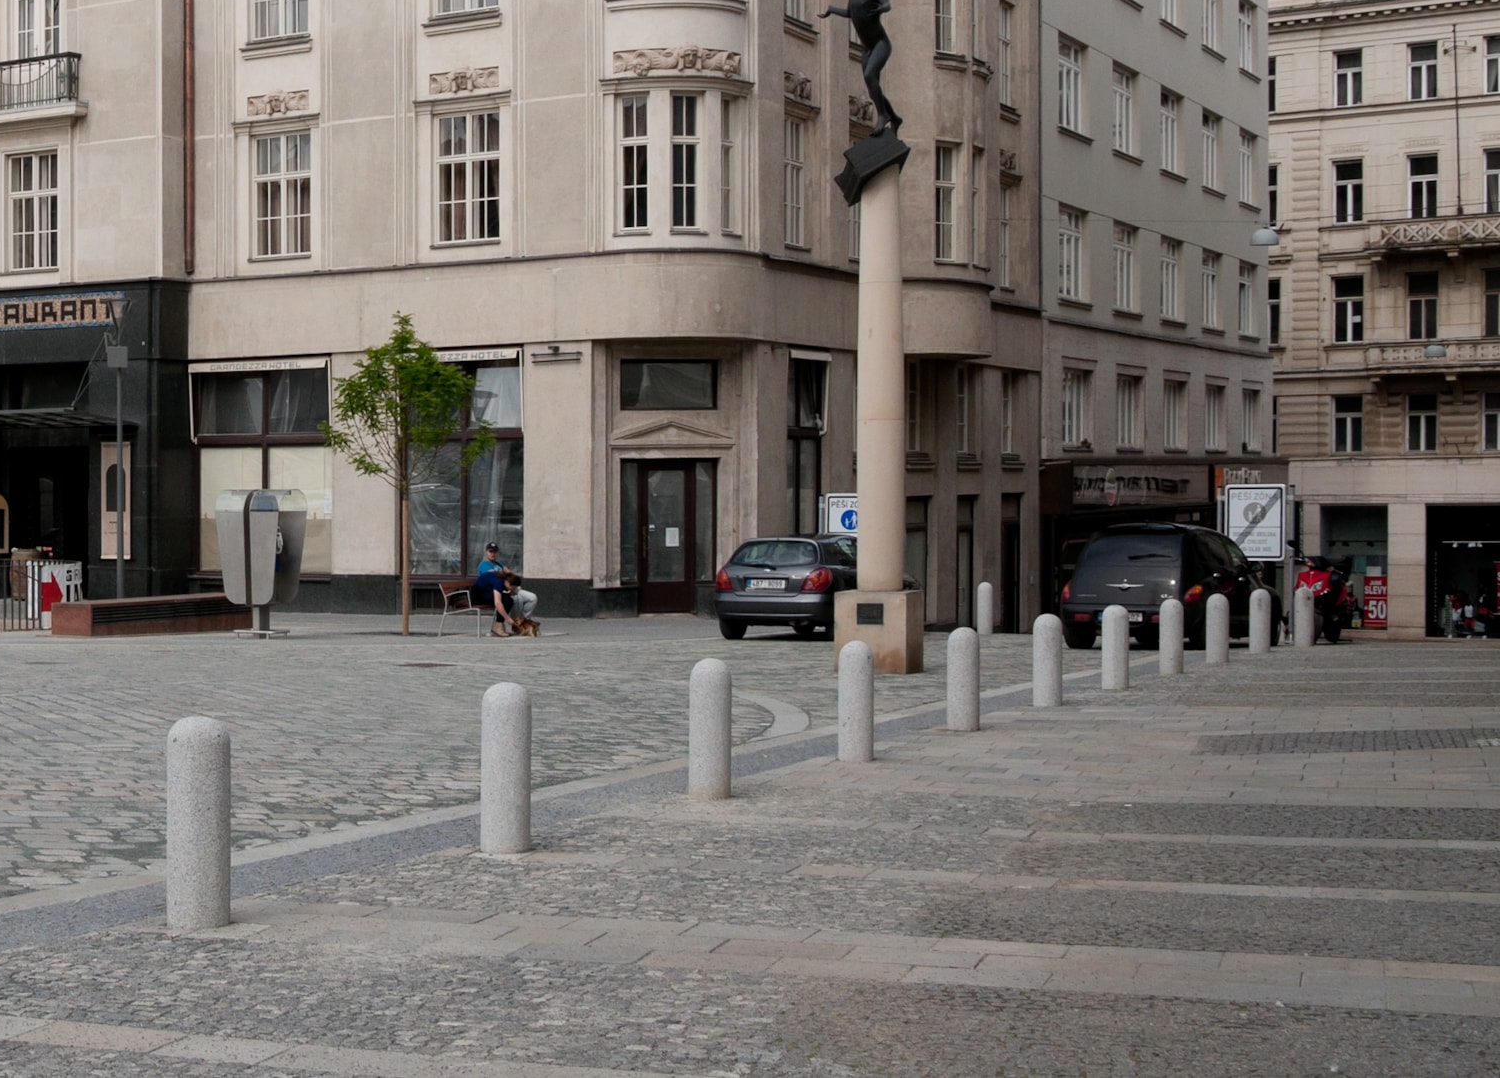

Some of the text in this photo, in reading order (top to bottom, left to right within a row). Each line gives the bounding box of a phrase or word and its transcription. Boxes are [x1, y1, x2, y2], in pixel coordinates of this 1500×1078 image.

[470, 350, 507, 360] HOTEL
[268, 360, 302, 370] HOTEL
[1364, 585, 1387, 595] SLEVY
